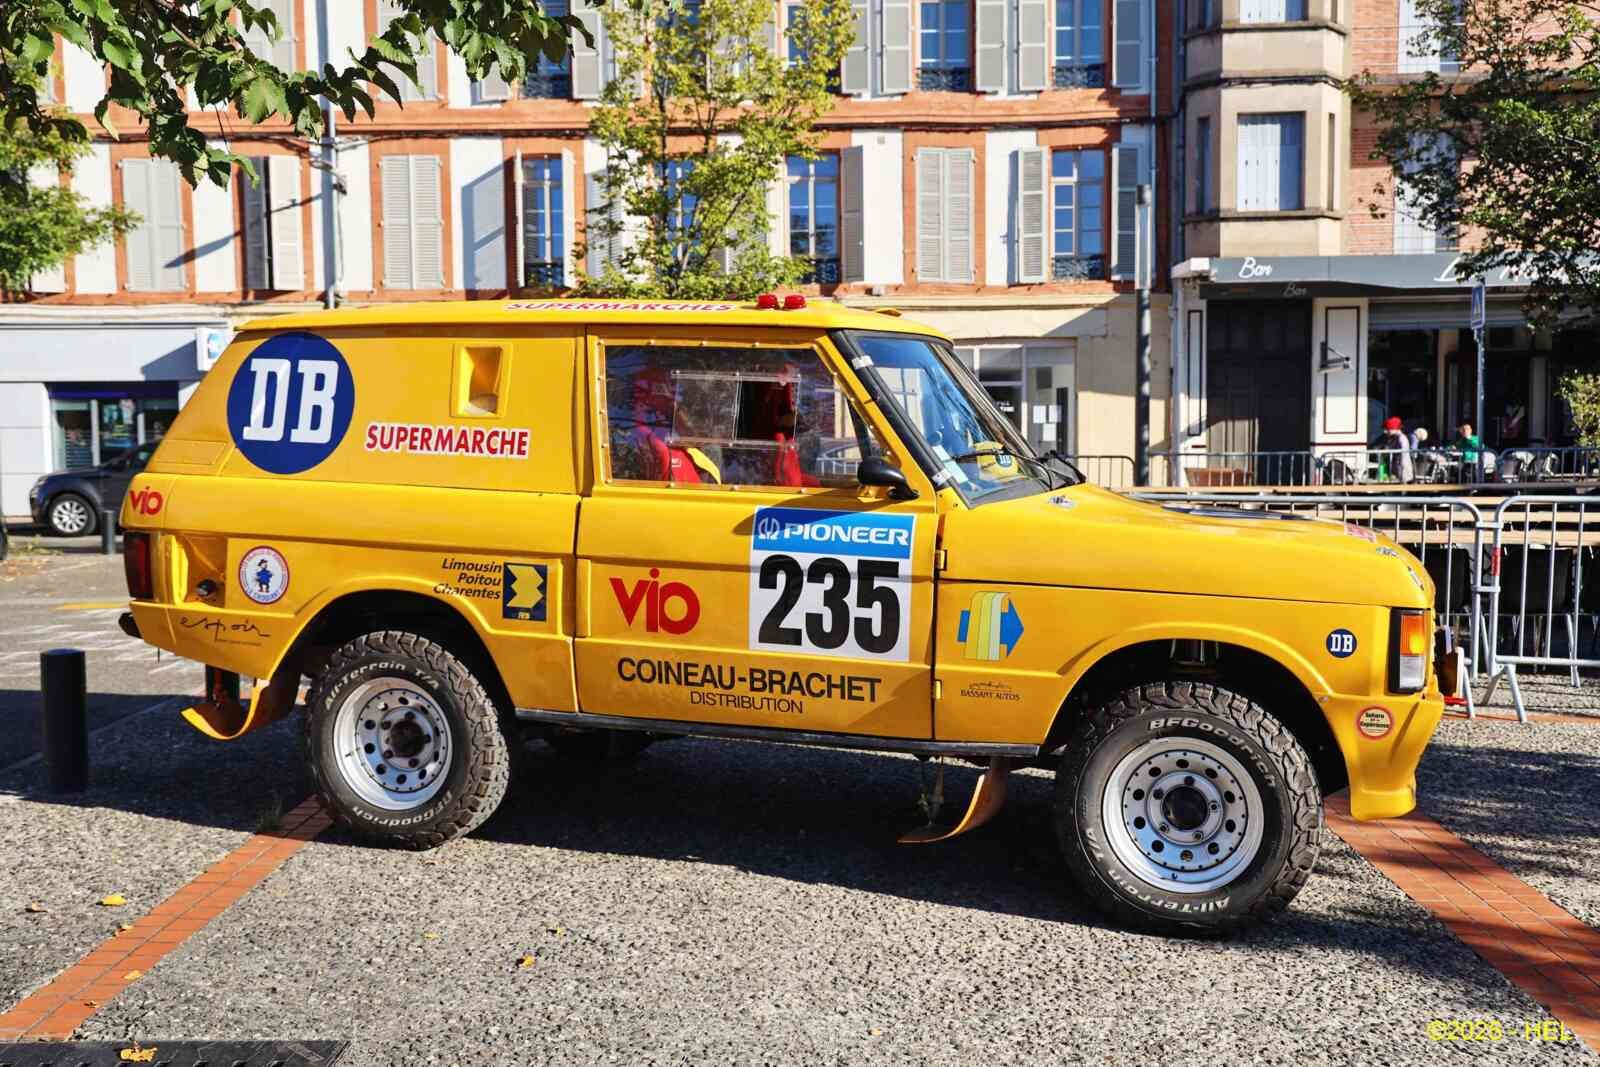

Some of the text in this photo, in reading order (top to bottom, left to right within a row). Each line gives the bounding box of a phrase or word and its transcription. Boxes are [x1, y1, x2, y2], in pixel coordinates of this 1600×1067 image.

[1238, 256, 1273, 278] Bar
[507, 302, 736, 311] SUPERMARCHES
[242, 358, 339, 444] DB
[366, 425, 529, 456] SUPERMARCHE
[129, 485, 163, 515] vio
[784, 522, 910, 546] PIONEER
[442, 558, 502, 574] Limousin
[457, 572, 502, 586] Poitou
[433, 583, 502, 600] Charentes
[609, 568, 701, 635] vio
[758, 554, 901, 654] 235
[1330, 634, 1353, 652] DB
[325, 661, 406, 710] All-Terrain
[617, 656, 882, 704] COINEAU-BRACHET
[690, 692, 803, 715] DISTRIBUTION
[1150, 718, 1275, 787] BFGoodrich
